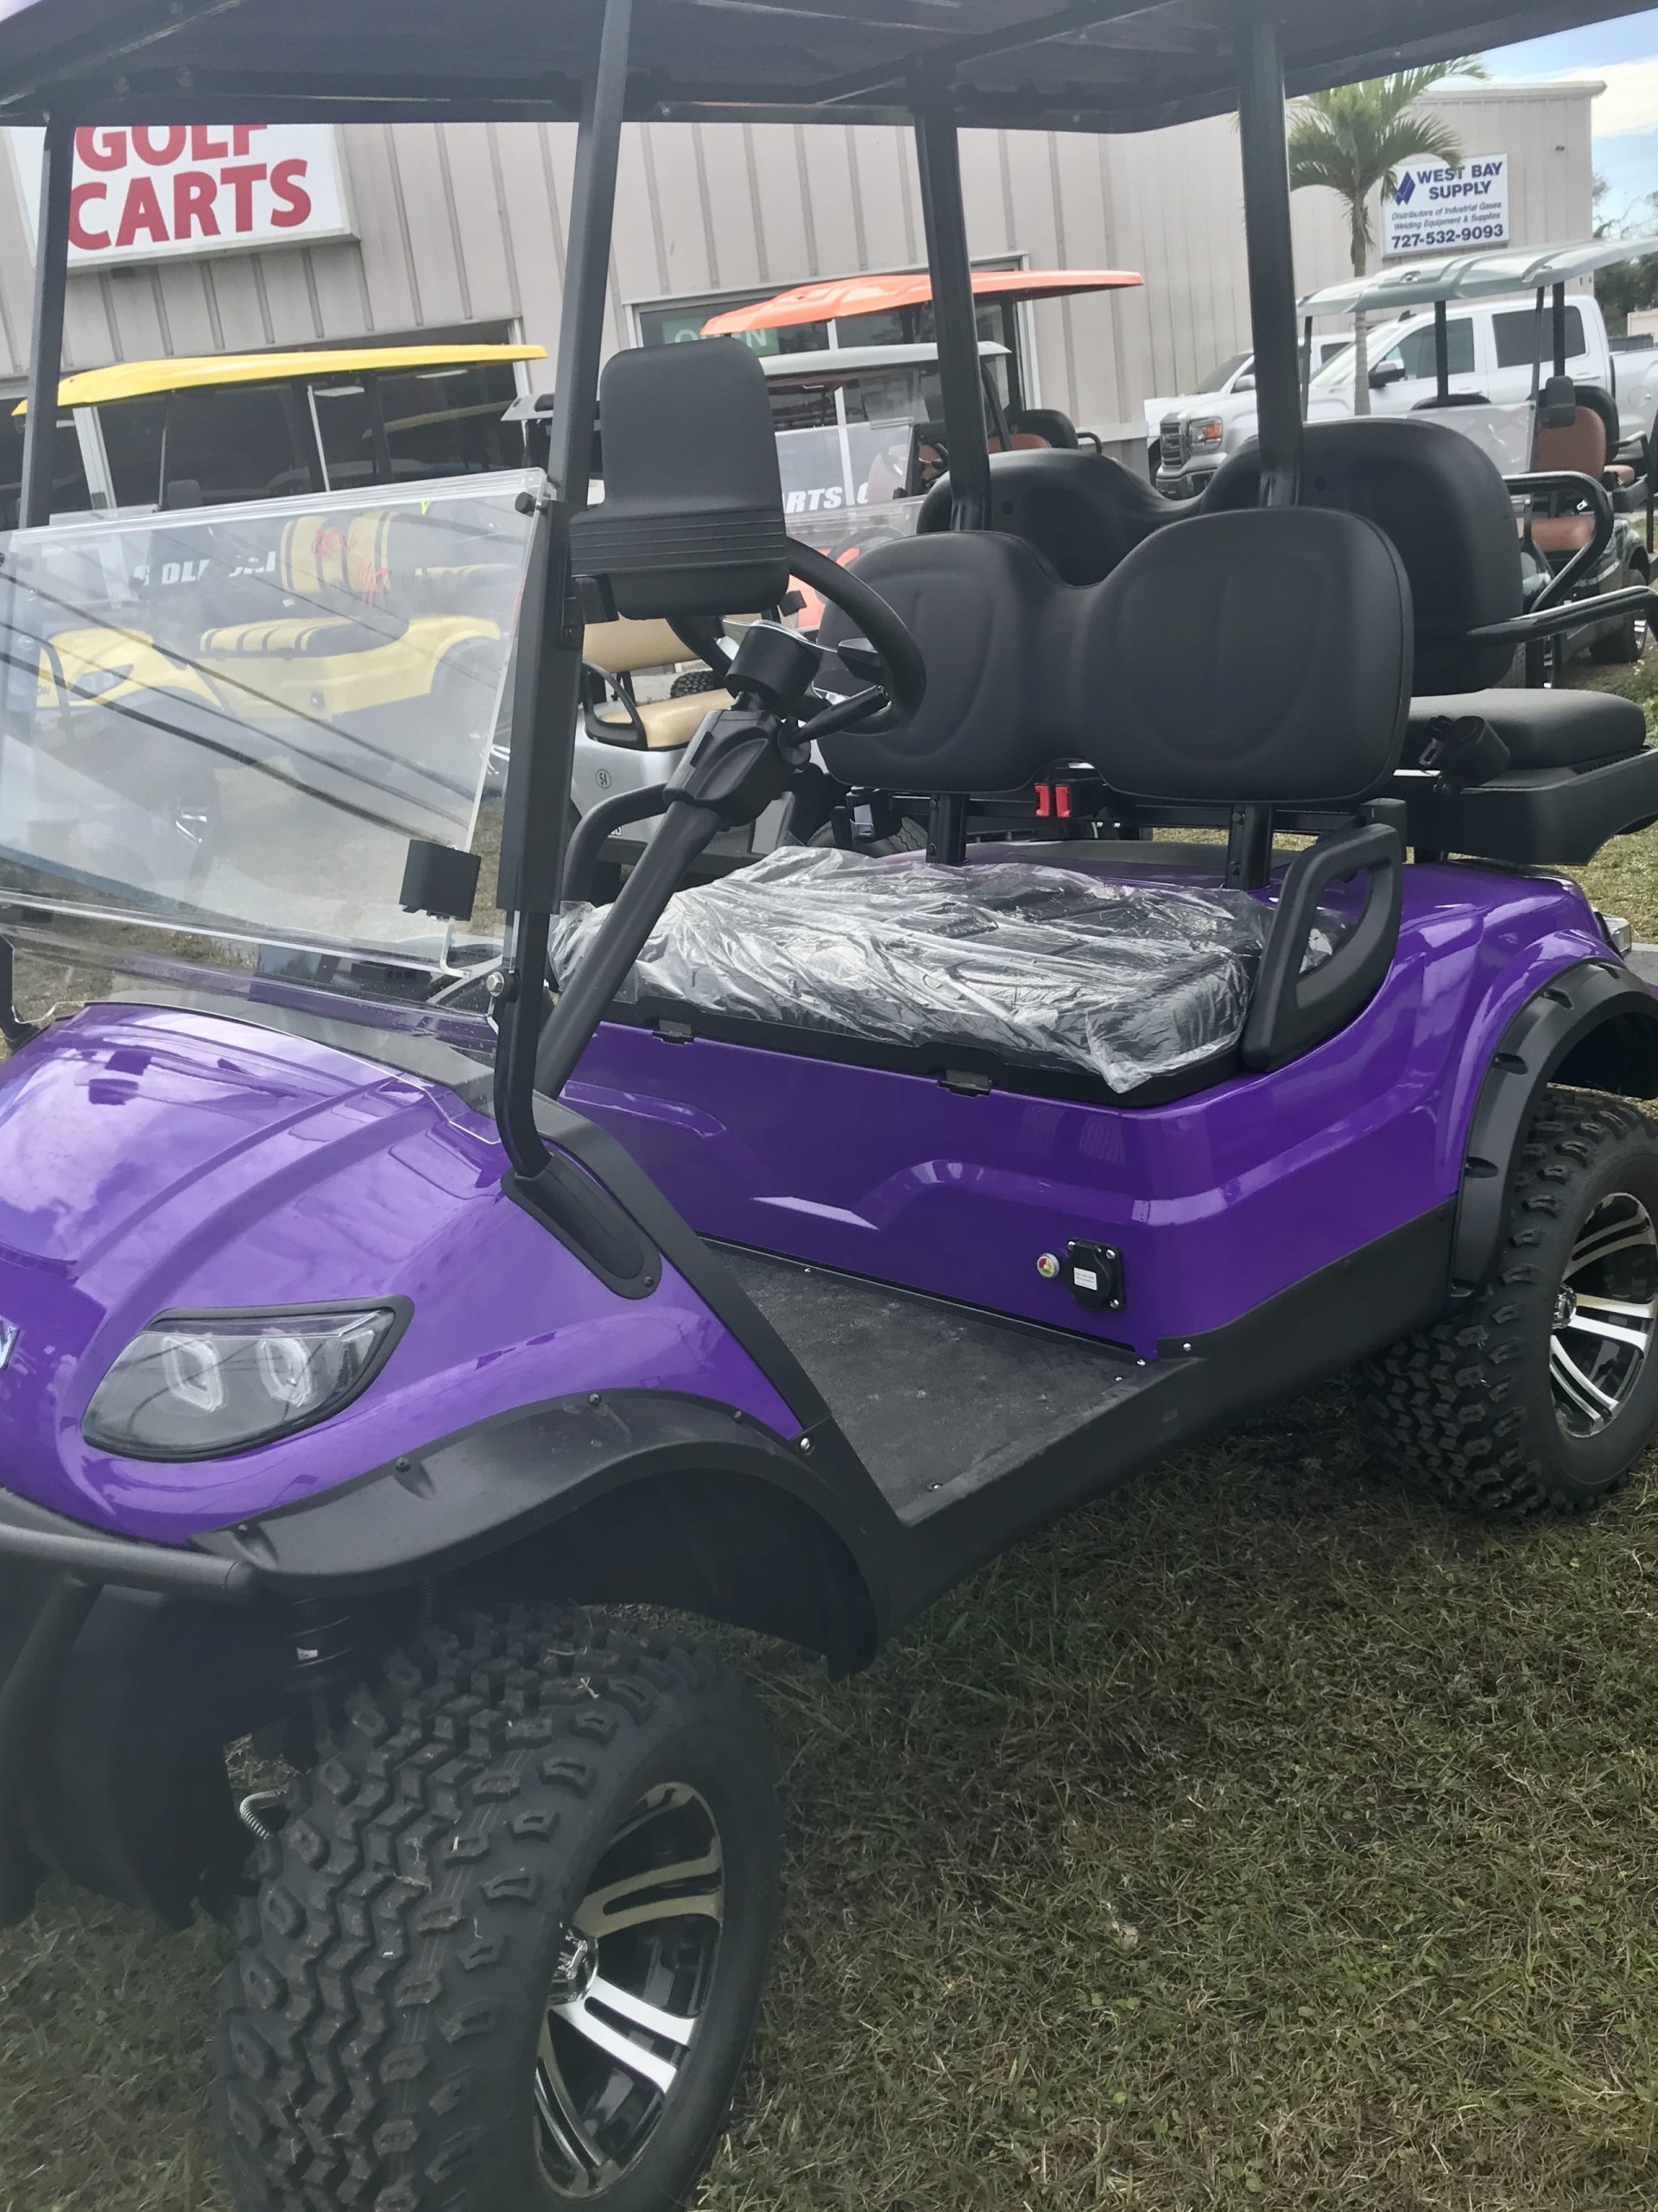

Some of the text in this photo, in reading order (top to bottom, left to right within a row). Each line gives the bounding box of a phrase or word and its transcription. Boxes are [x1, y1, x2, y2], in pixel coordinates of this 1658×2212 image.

[1417, 162, 1503, 185] WEST BAY
[1429, 181, 1491, 200] SUPPLY
[68, 158, 312, 250] CARTS
[1392, 209, 1433, 220] Distributors
[1444, 203, 1478, 214] Industrial
[1479, 201, 1502, 210] Gases
[1395, 219, 1421, 231] Welding
[1424, 216, 1461, 228] Equipment
[1471, 212, 1501, 223] Supplies
[1391, 224, 1503, 249] 727-532-9093
[782, 486, 843, 513] RTS
